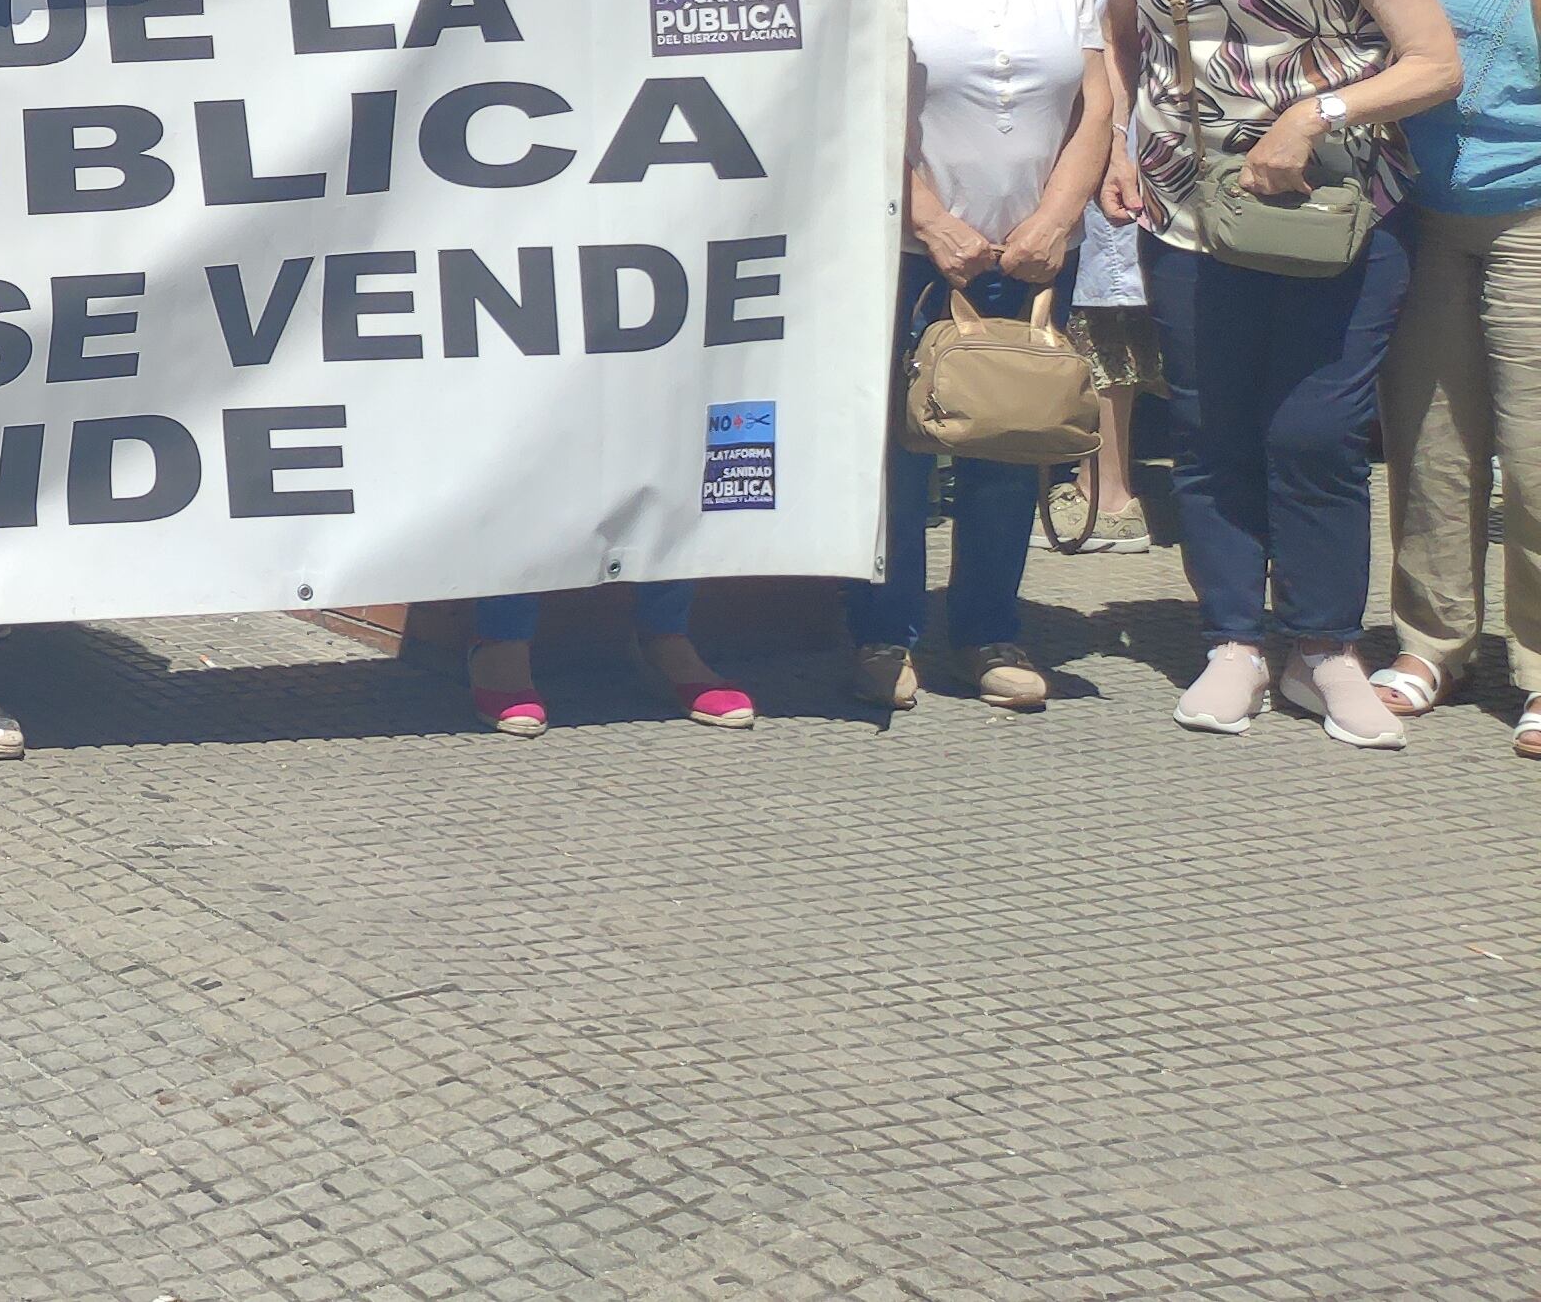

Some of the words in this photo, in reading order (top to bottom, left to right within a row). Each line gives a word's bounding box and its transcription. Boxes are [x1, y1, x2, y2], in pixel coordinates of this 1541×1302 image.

[656, 2, 796, 34] PÚBLICA
[657, 34, 681, 45] DEL
[683, 31, 727, 44] BIERZO
[727, 31, 740, 42] Y
[742, 29, 796, 41] LACIANA
[204, 235, 787, 367] VENDE
[705, 448, 772, 462] PLATAFORMA
[723, 466, 772, 478] SANIDAD
[703, 478, 773, 498] PÚBLICA
